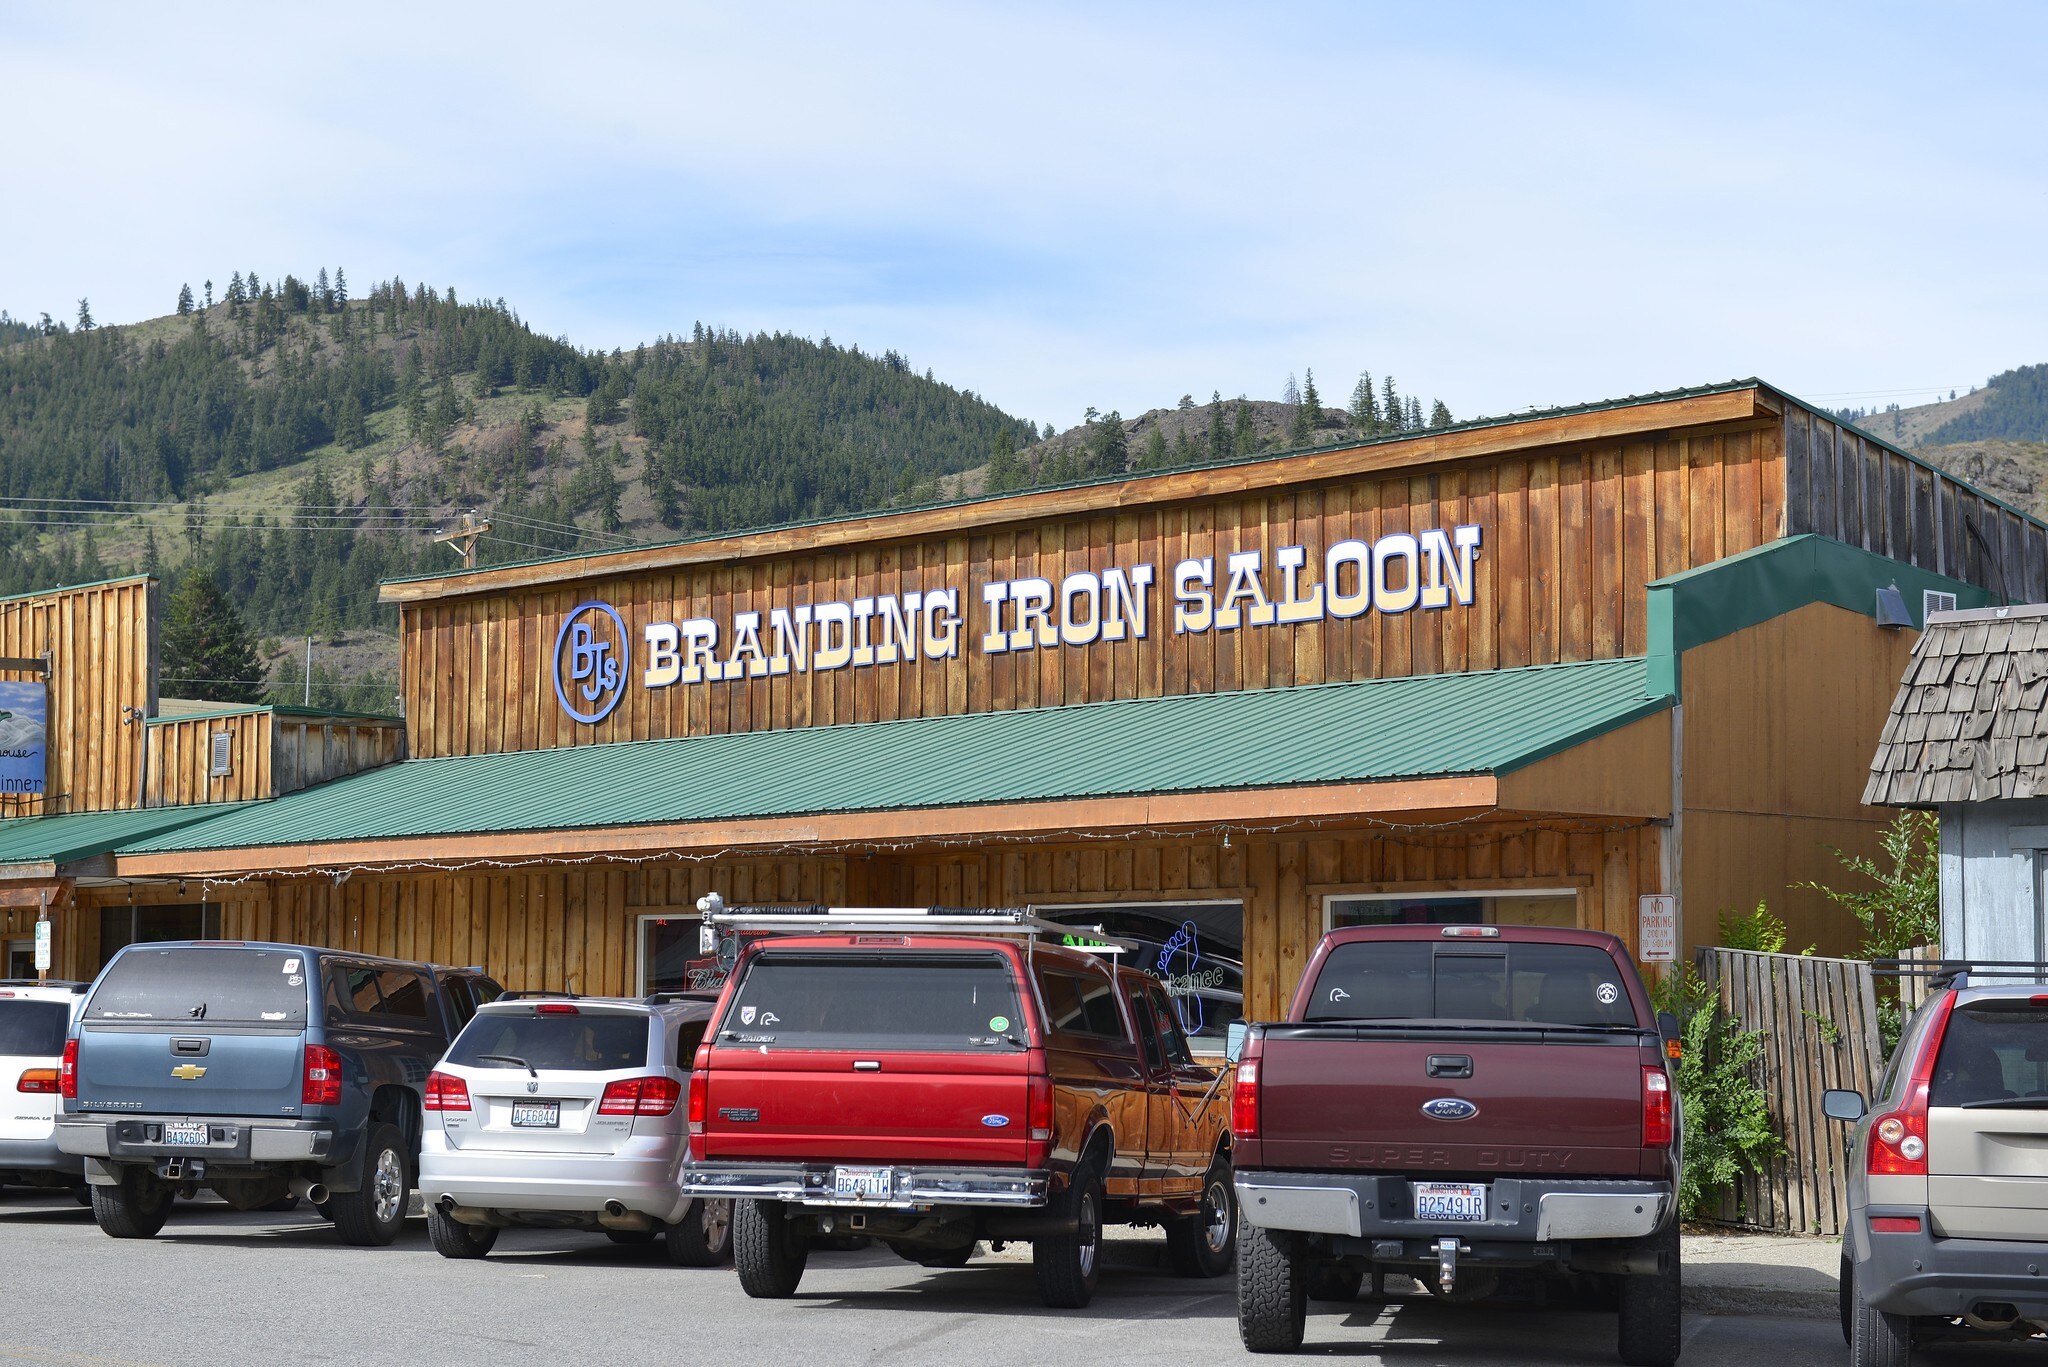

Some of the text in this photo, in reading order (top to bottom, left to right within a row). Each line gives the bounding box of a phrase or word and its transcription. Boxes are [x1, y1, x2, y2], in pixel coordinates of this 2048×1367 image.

[645, 523, 1481, 688] BRANDING IRON SALOON
[0, 749, 38, 758] ouse
[1651, 901, 1664, 913] NO
[1643, 916, 1672, 928] PARKING
[1660, 929, 1668, 938] AM
[1665, 940, 1673, 948] AM
[514, 1109, 555, 1122] ACE6844
[1329, 1148, 1573, 1167] SUPER DUTY
[838, 1178, 889, 1193] B64811W
[1420, 1197, 1482, 1214] B25491R
